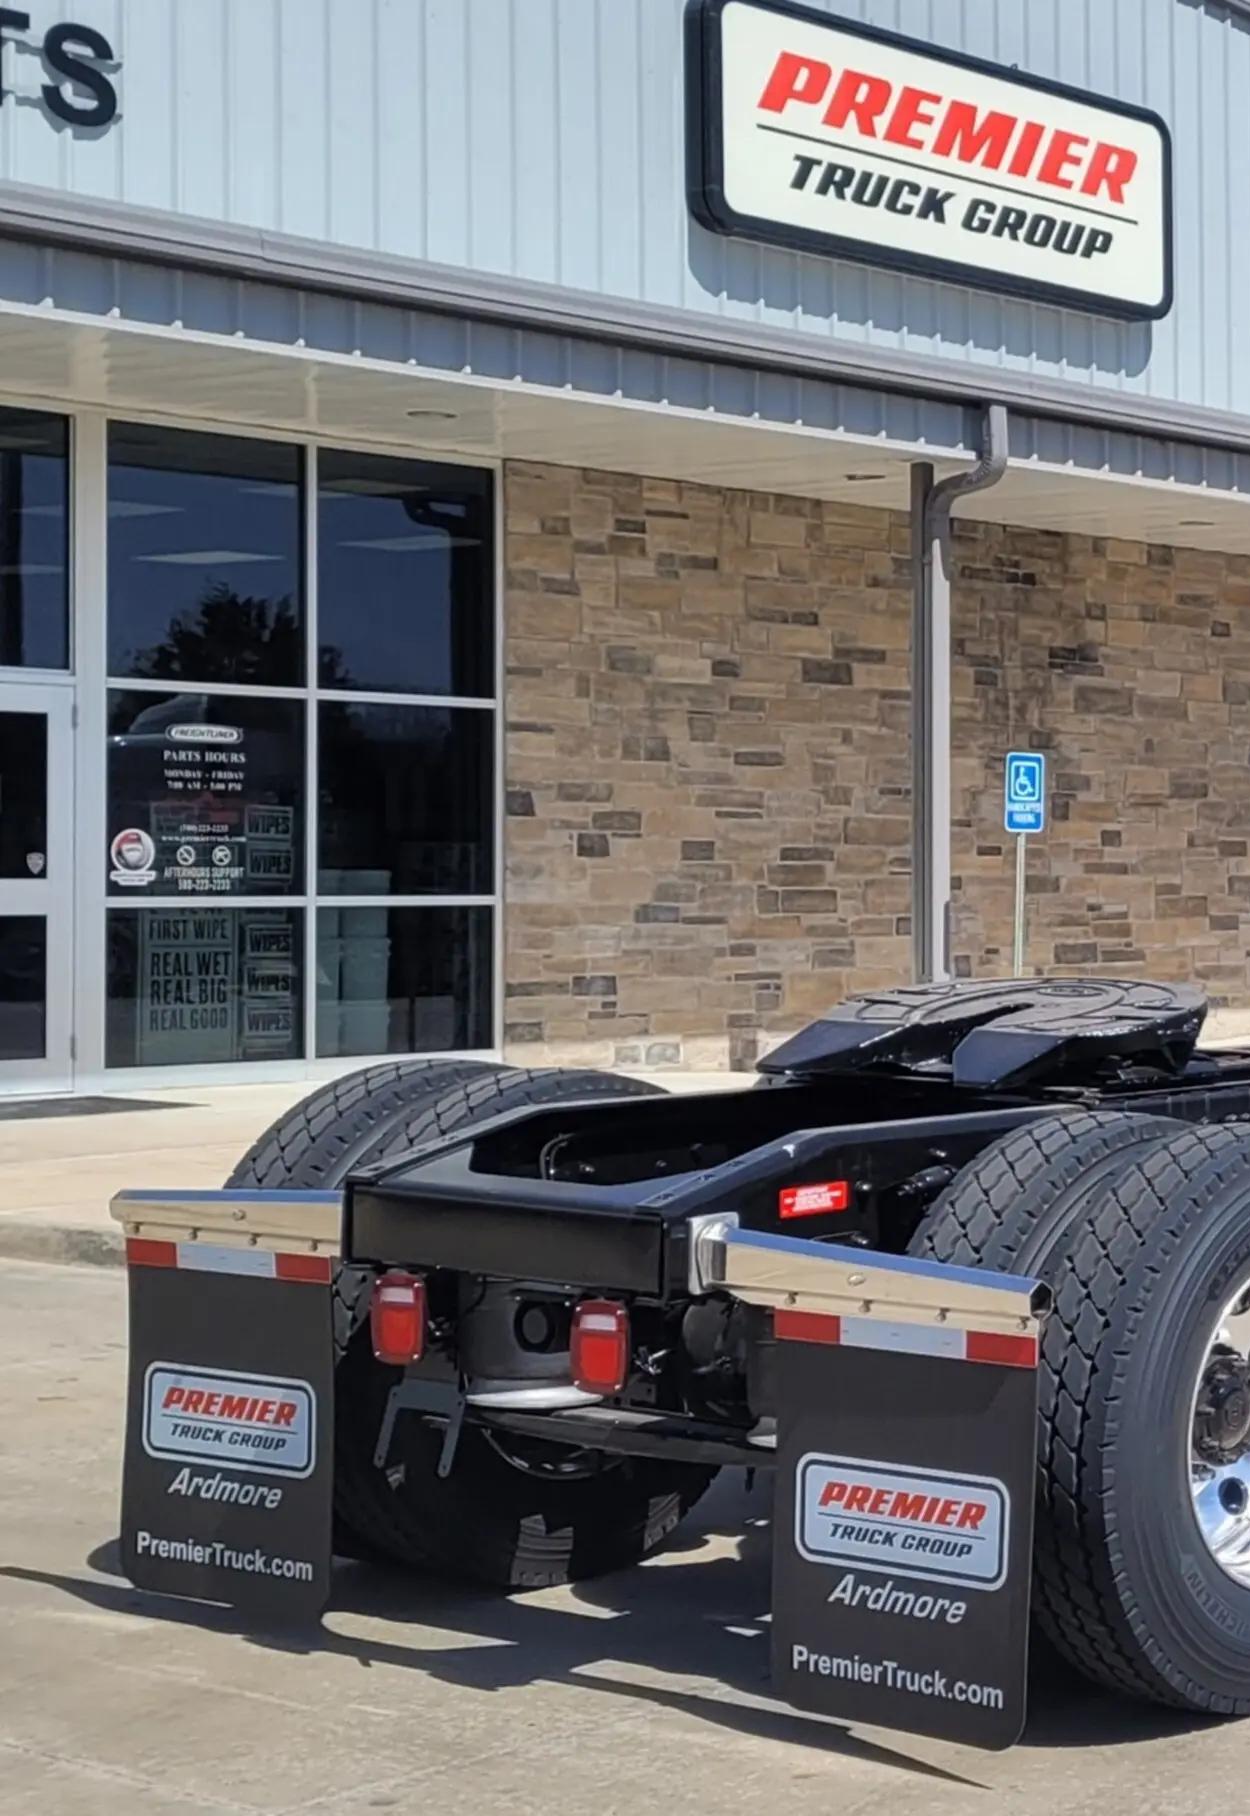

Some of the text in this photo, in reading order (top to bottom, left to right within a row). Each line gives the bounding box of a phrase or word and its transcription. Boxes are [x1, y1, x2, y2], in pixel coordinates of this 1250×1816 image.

[757, 50, 1138, 204] PREMIER
[789, 154, 1114, 260] TRUCK GROUP
[163, 750, 246, 763] PARTS HOURS
[164, 769, 202, 778] MONDAY
[211, 771, 244, 780] FRIDAY
[248, 815, 291, 834] WIPES
[163, 866, 211, 878] AFTERHOURS
[211, 866, 245, 879] SUPPORT
[250, 855, 291, 873] WIPES
[149, 918, 229, 940] FIRST WIPE
[249, 932, 290, 953] WIPES
[151, 951, 233, 977] REAL WET
[151, 978, 227, 1006] REAL BIG
[247, 972, 291, 993] WIPES
[149, 1007, 228, 1031] REAL GOOD
[247, 1012, 291, 1033] WIPES
[161, 1386, 298, 1427] PREMIER
[169, 1422, 287, 1452] TRUCK GROUP
[167, 1467, 283, 1509] Ardmore
[818, 1481, 987, 1531] PREMIER
[829, 1522, 973, 1559] TRUCK GROUP
[136, 1530, 313, 1582] PremierTruck.com
[827, 1573, 968, 1624] Ardmore
[792, 1643, 1004, 1709] PremierTruck.com
